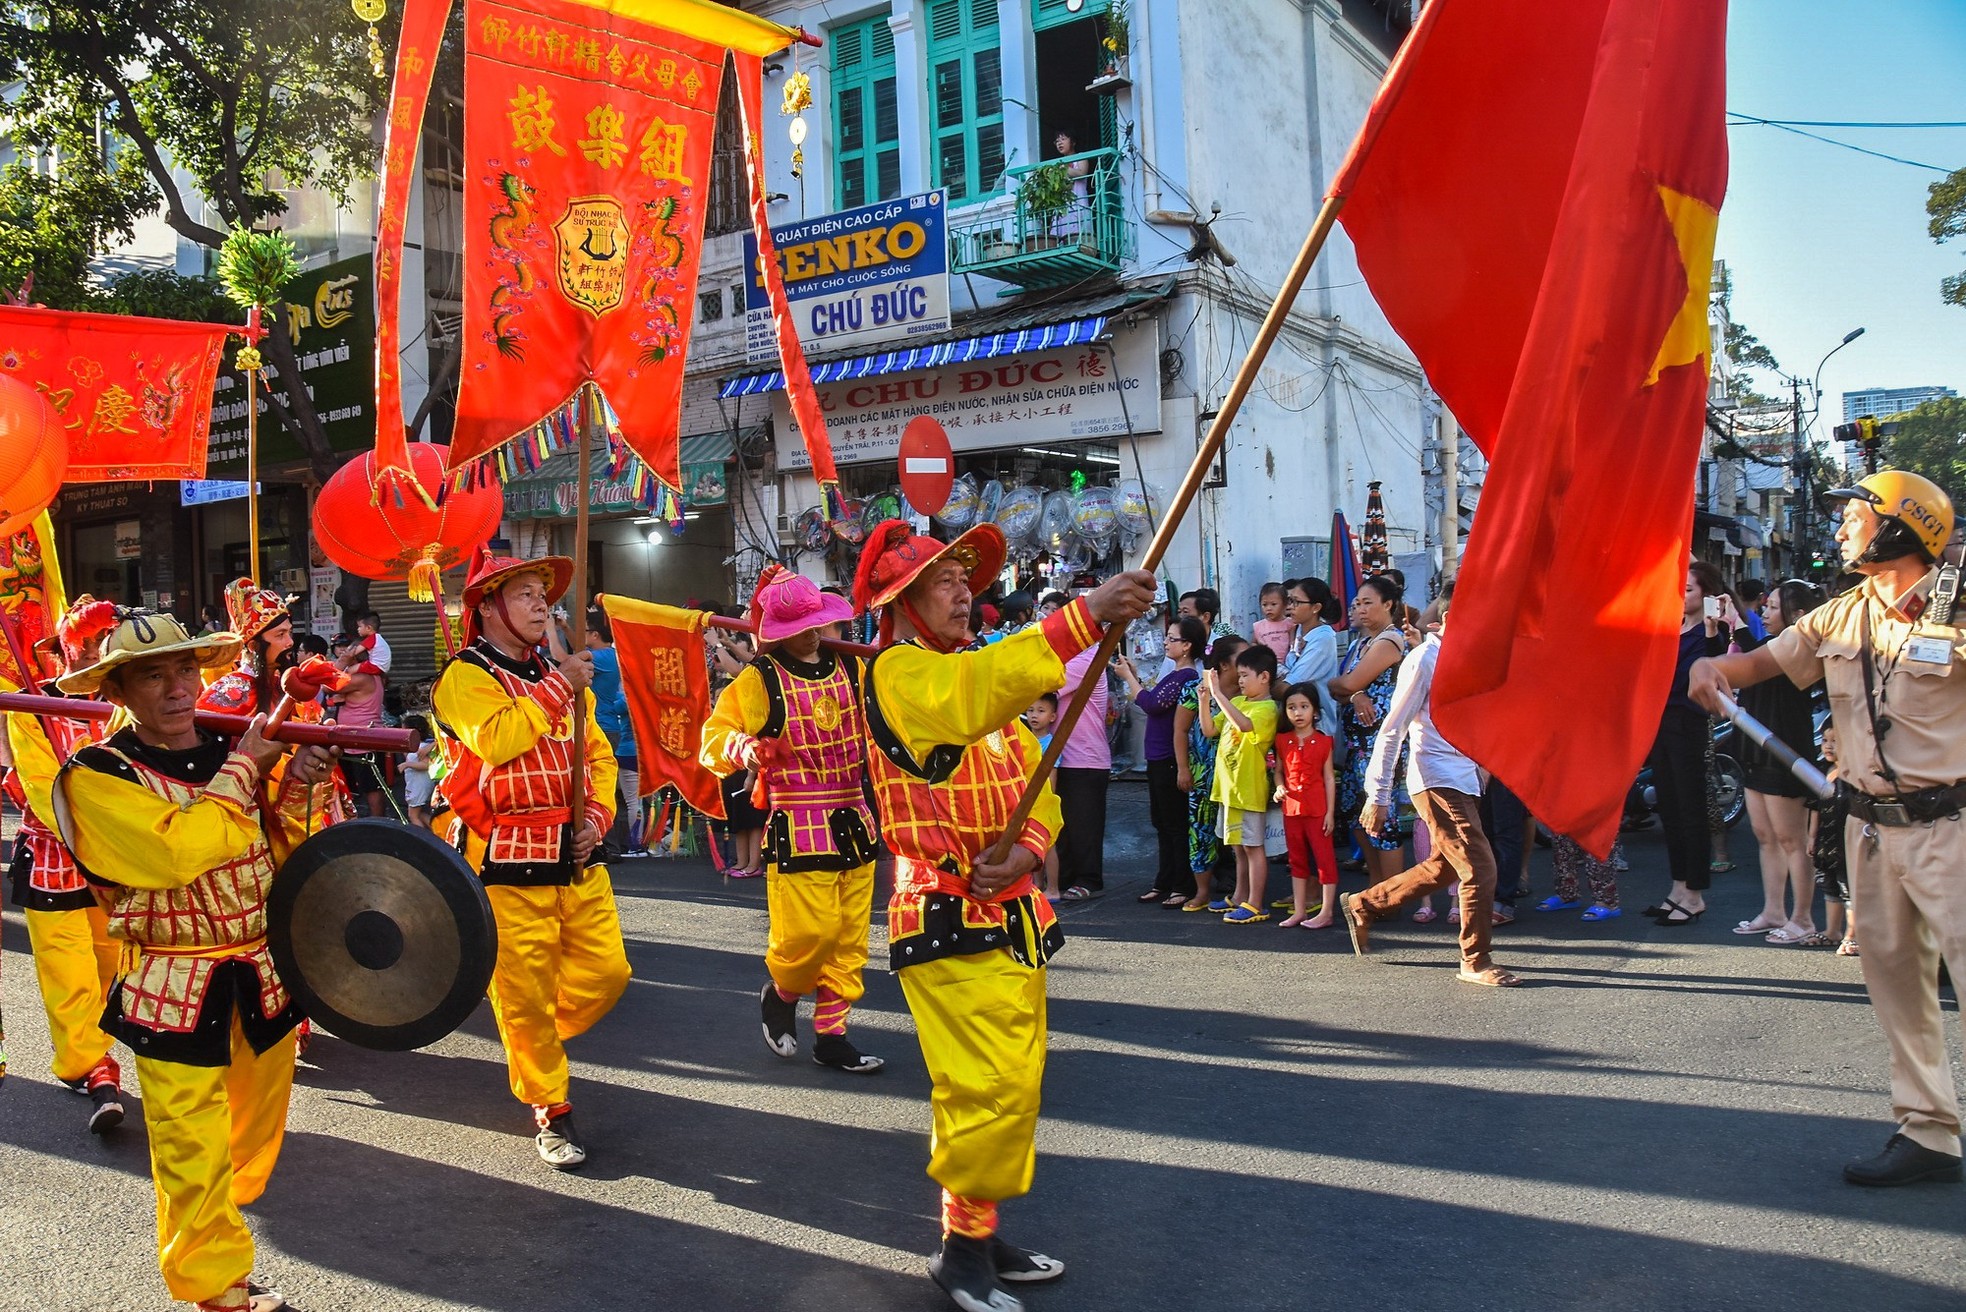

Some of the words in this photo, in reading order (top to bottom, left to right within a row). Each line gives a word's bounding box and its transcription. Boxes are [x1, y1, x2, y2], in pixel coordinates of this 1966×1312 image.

[506, 83, 693, 187] 鼓樂組
[776, 226, 810, 243] QUẠT
[811, 219, 842, 236] ĐIỆN
[844, 212, 872, 228] CAO
[874, 203, 903, 220] CẤP
[798, 282, 819, 294] MÁT
[821, 277, 845, 289] CHO
[847, 270, 878, 284] CUỘC
[880, 264, 911, 277] SỐNG
[747, 310, 762, 323] CỬA
[811, 290, 863, 336] CHÚ
[871, 282, 927, 325] ĐỨC
[959, 359, 1064, 394] ĐỨC
[827, 411, 858, 428] DOANH
[860, 410, 880, 423] CÁC
[881, 408, 901, 421] MẶT
[903, 404, 930, 418] HÀNG
[933, 400, 956, 414] ĐIỆN
[991, 391, 1022, 406] NHẬN
[1023, 386, 1044, 402] SỬA
[1047, 383, 1077, 399] CHỮA
[1079, 381, 1105, 397] ĐIỆN
[833, 442, 852, 453] GUYỄN
[1088, 424, 1109, 434] 3856
[1900, 498, 1945, 538] CSGT
